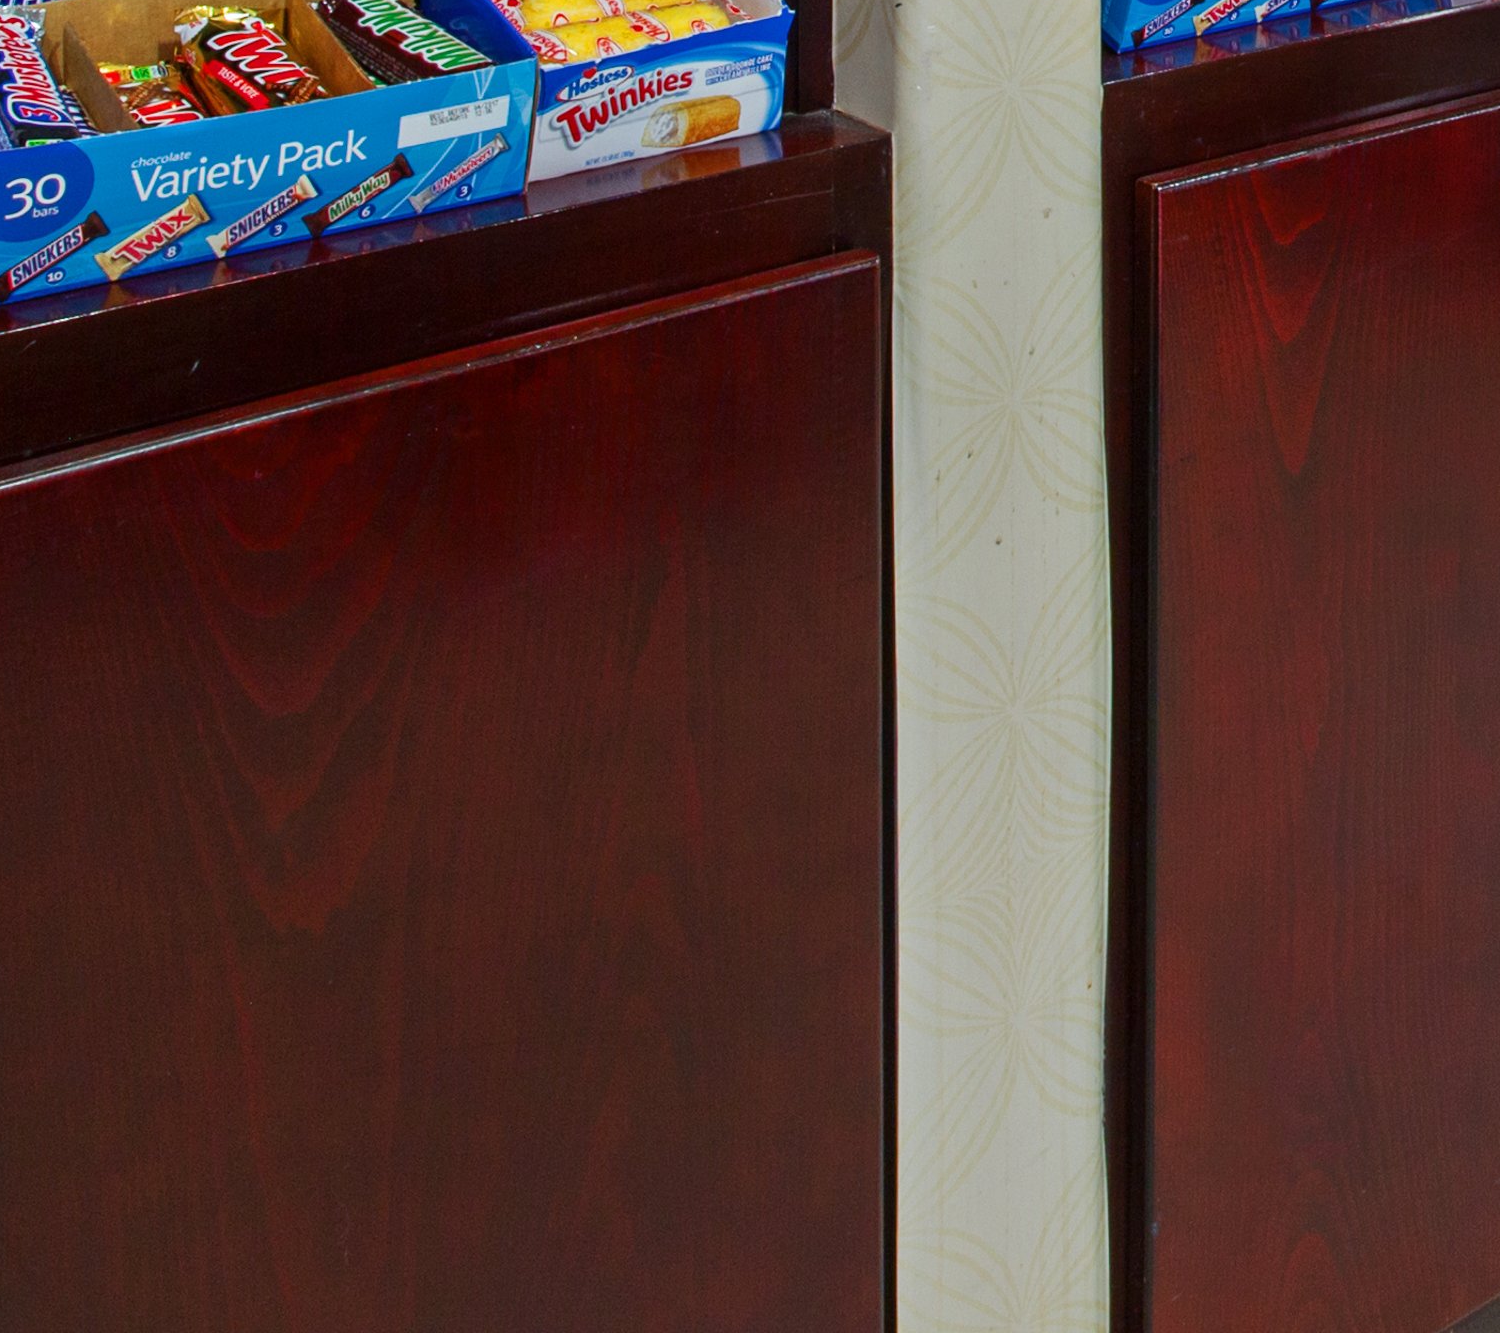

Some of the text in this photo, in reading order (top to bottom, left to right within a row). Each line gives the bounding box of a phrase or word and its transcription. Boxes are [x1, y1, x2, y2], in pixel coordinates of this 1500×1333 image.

[567, 66, 629, 100] Hostess
[20, 106, 62, 122] 3
[556, 69, 694, 143] Twinkies
[130, 150, 193, 170] chocolate
[130, 130, 368, 203] Variety Pack
[3, 173, 67, 221] 30
[460, 185, 468, 196] 3
[32, 205, 60, 219] bars
[228, 187, 296, 243] SNICKERS
[361, 205, 371, 217] 6
[110, 208, 197, 265] TWIX
[274, 224, 283, 236] 3
[12, 229, 83, 287] SNICKERS
[166, 246, 177, 258] 8
[46, 271, 64, 283] 10
